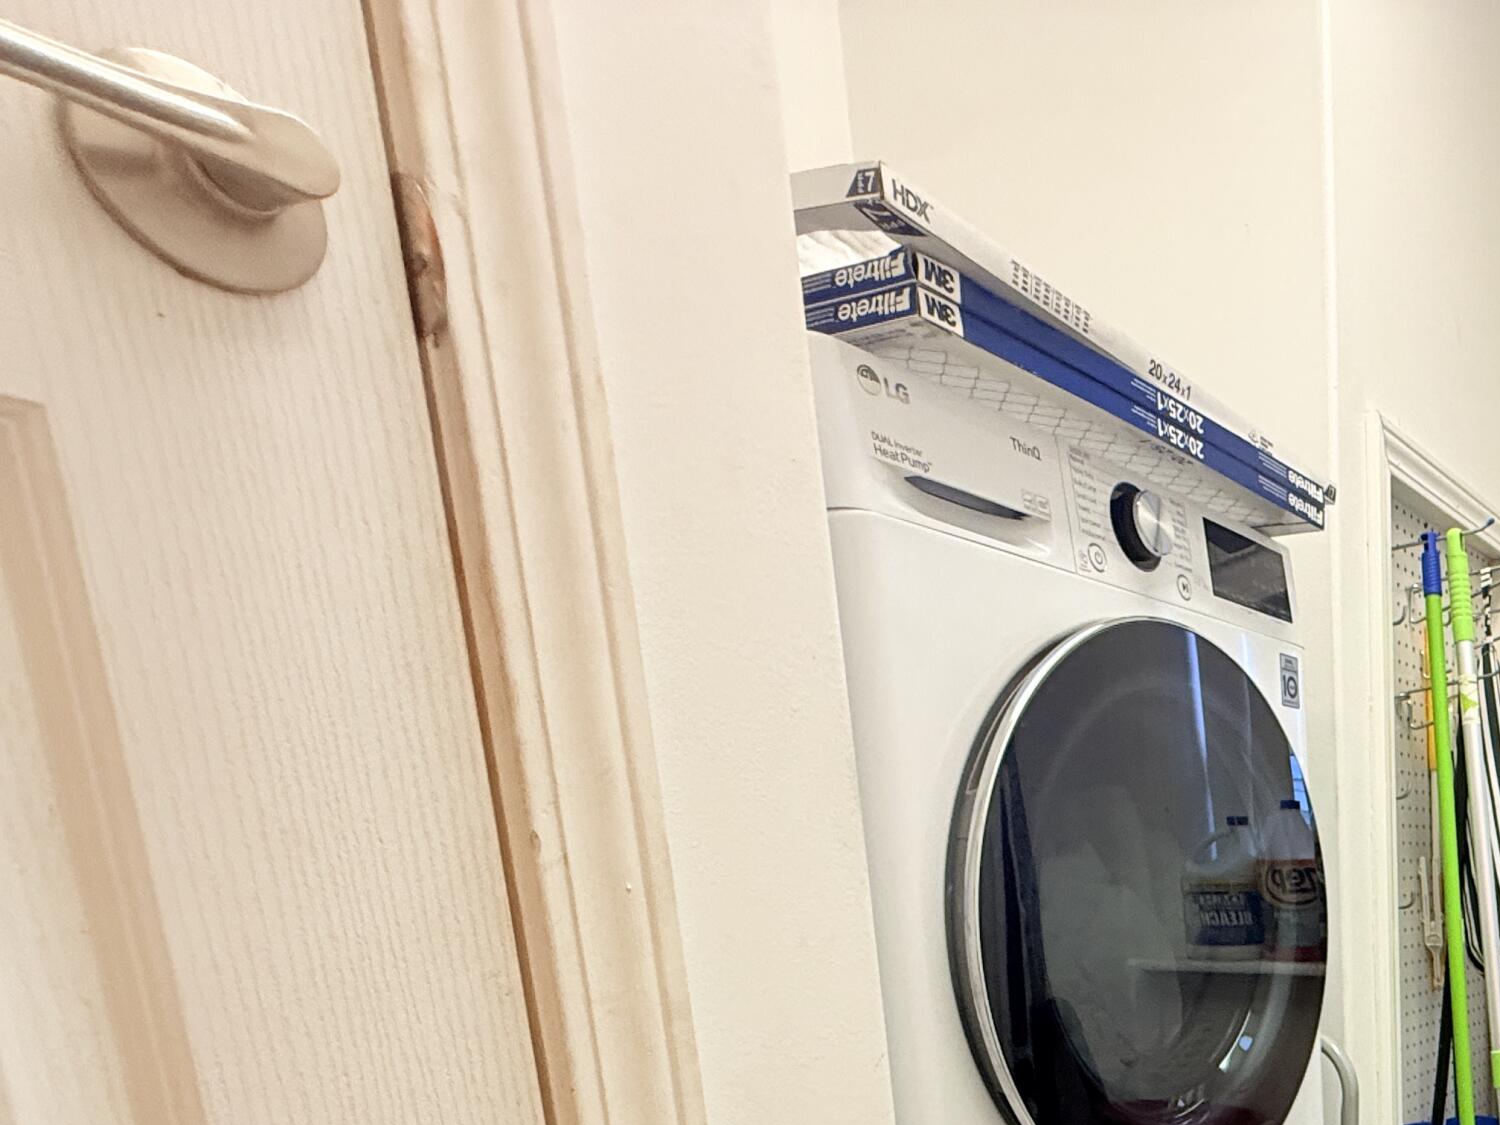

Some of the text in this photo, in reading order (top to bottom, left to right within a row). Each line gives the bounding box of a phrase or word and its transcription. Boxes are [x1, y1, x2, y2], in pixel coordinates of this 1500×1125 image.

[865, 171, 876, 193] 7
[891, 178, 931, 224] HDX
[834, 251, 906, 289] Filtrete
[923, 257, 955, 294] 3M
[837, 286, 911, 322] Filtrete
[924, 294, 957, 328] 3M
[883, 377, 910, 405] LG
[1009, 436, 1042, 461] ThinQ
[1288, 470, 1324, 504] Filtrete
[1288, 492, 1324, 526] Filtrete
